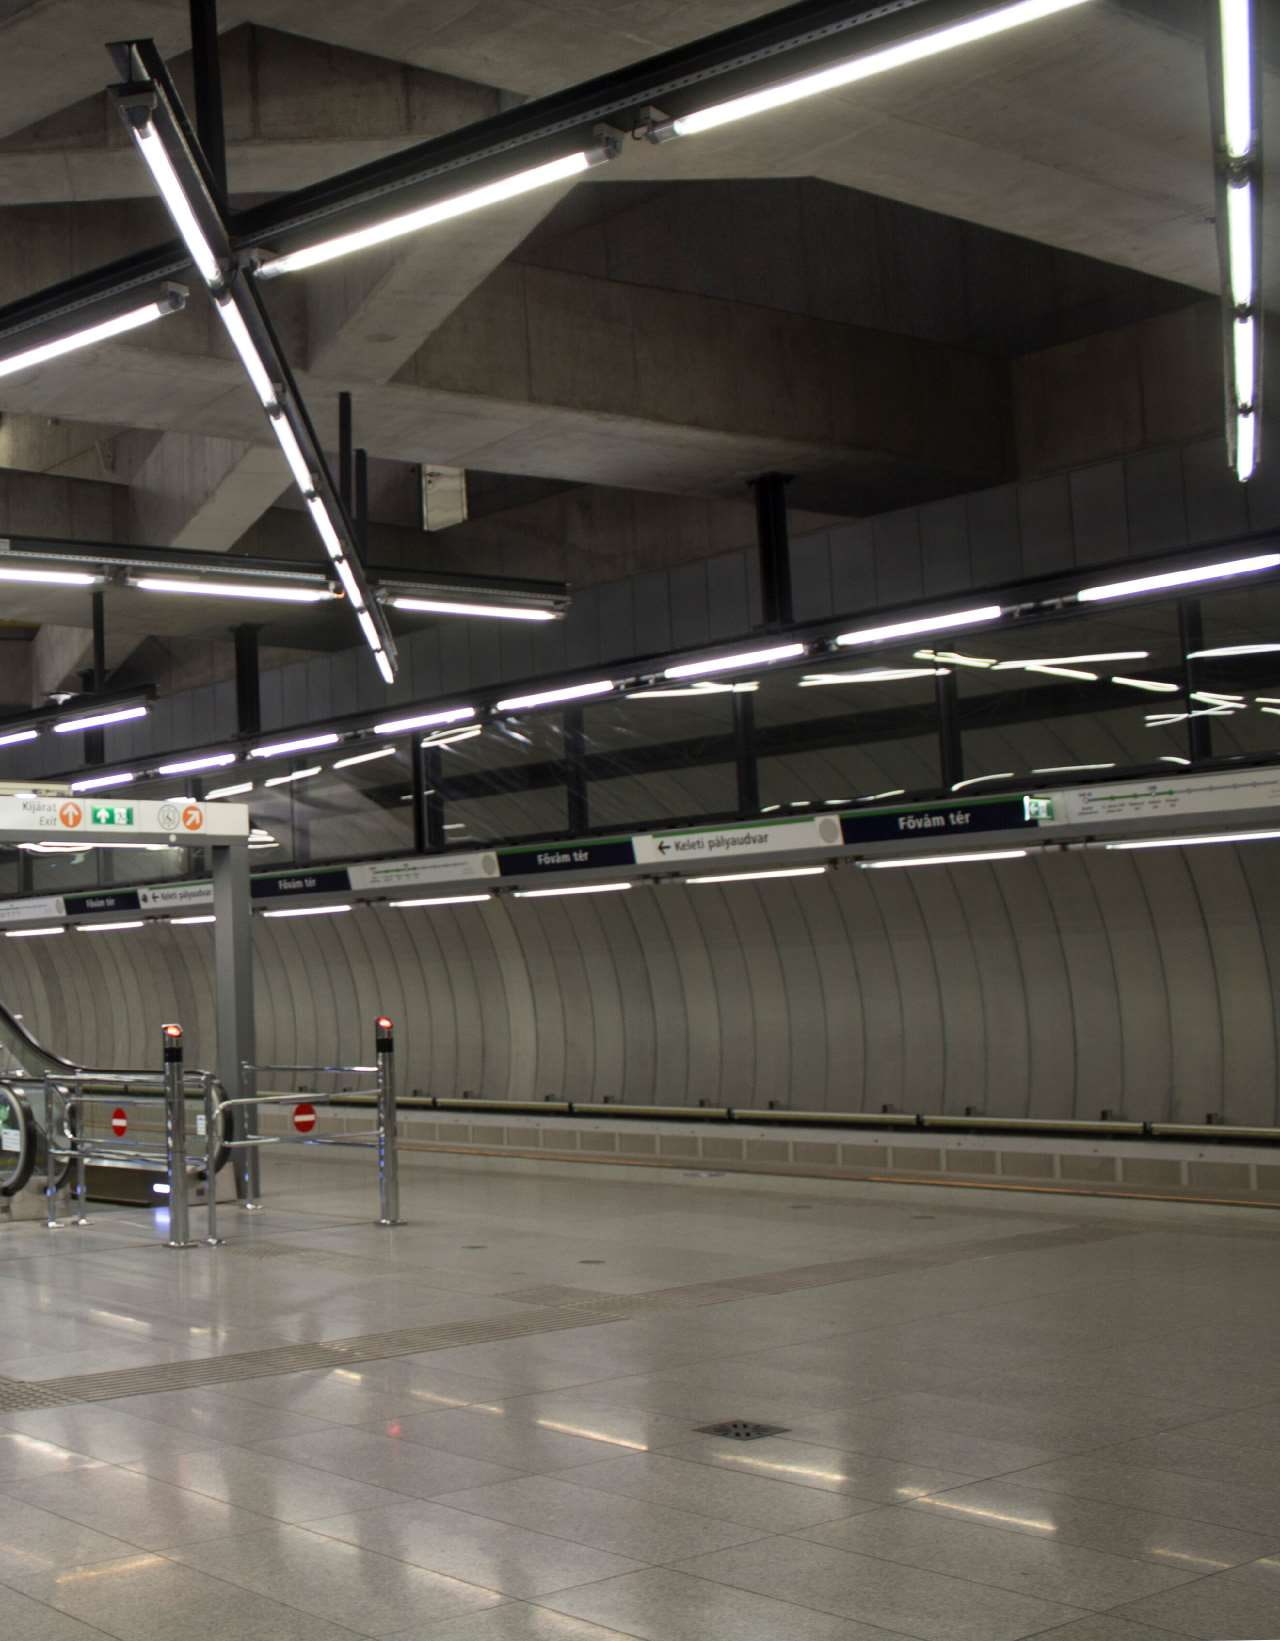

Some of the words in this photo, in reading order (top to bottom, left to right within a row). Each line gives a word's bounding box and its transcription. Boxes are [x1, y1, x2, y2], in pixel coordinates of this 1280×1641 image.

[39, 816, 57, 826] Exit
[898, 813, 946, 830] Fővám
[949, 811, 971, 826] tér
[573, 850, 590, 862] tér
